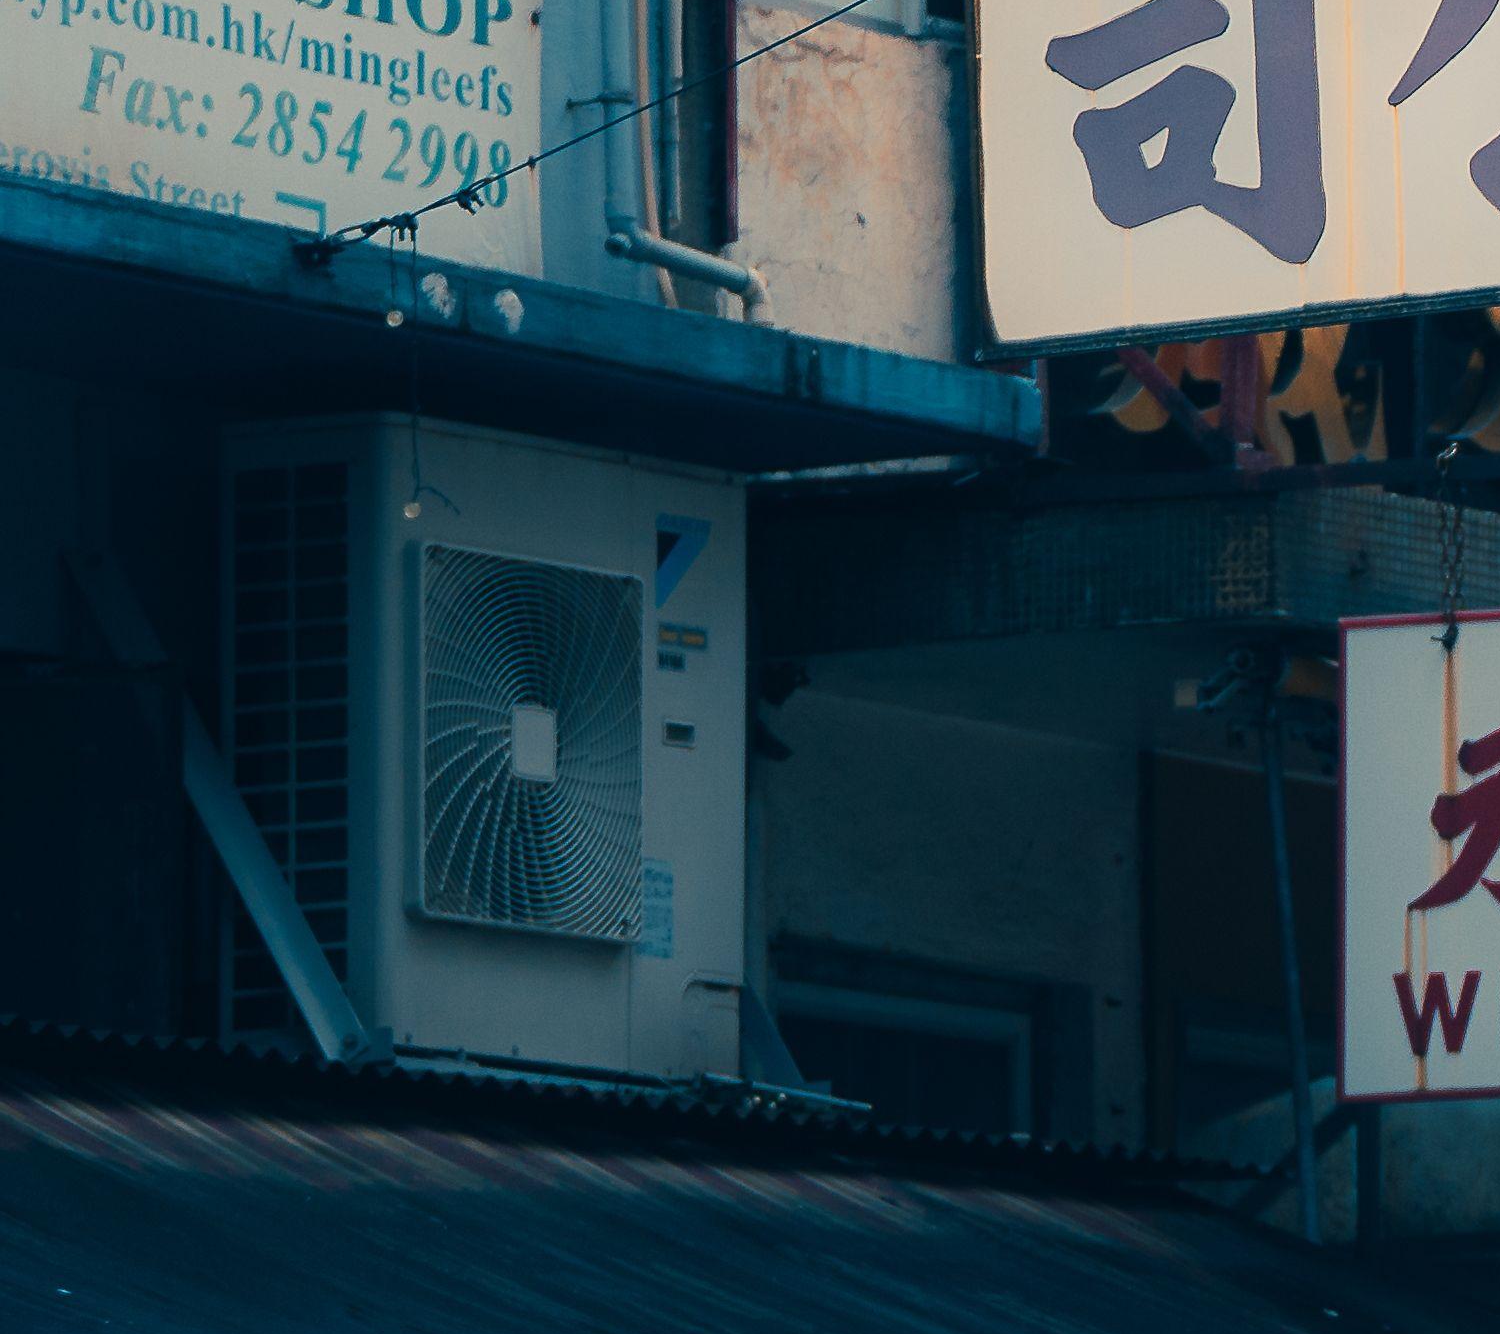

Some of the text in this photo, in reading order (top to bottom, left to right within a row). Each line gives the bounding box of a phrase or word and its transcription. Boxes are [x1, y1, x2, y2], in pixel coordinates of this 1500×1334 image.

[80, 44, 512, 209] Fax: 2854 2998
